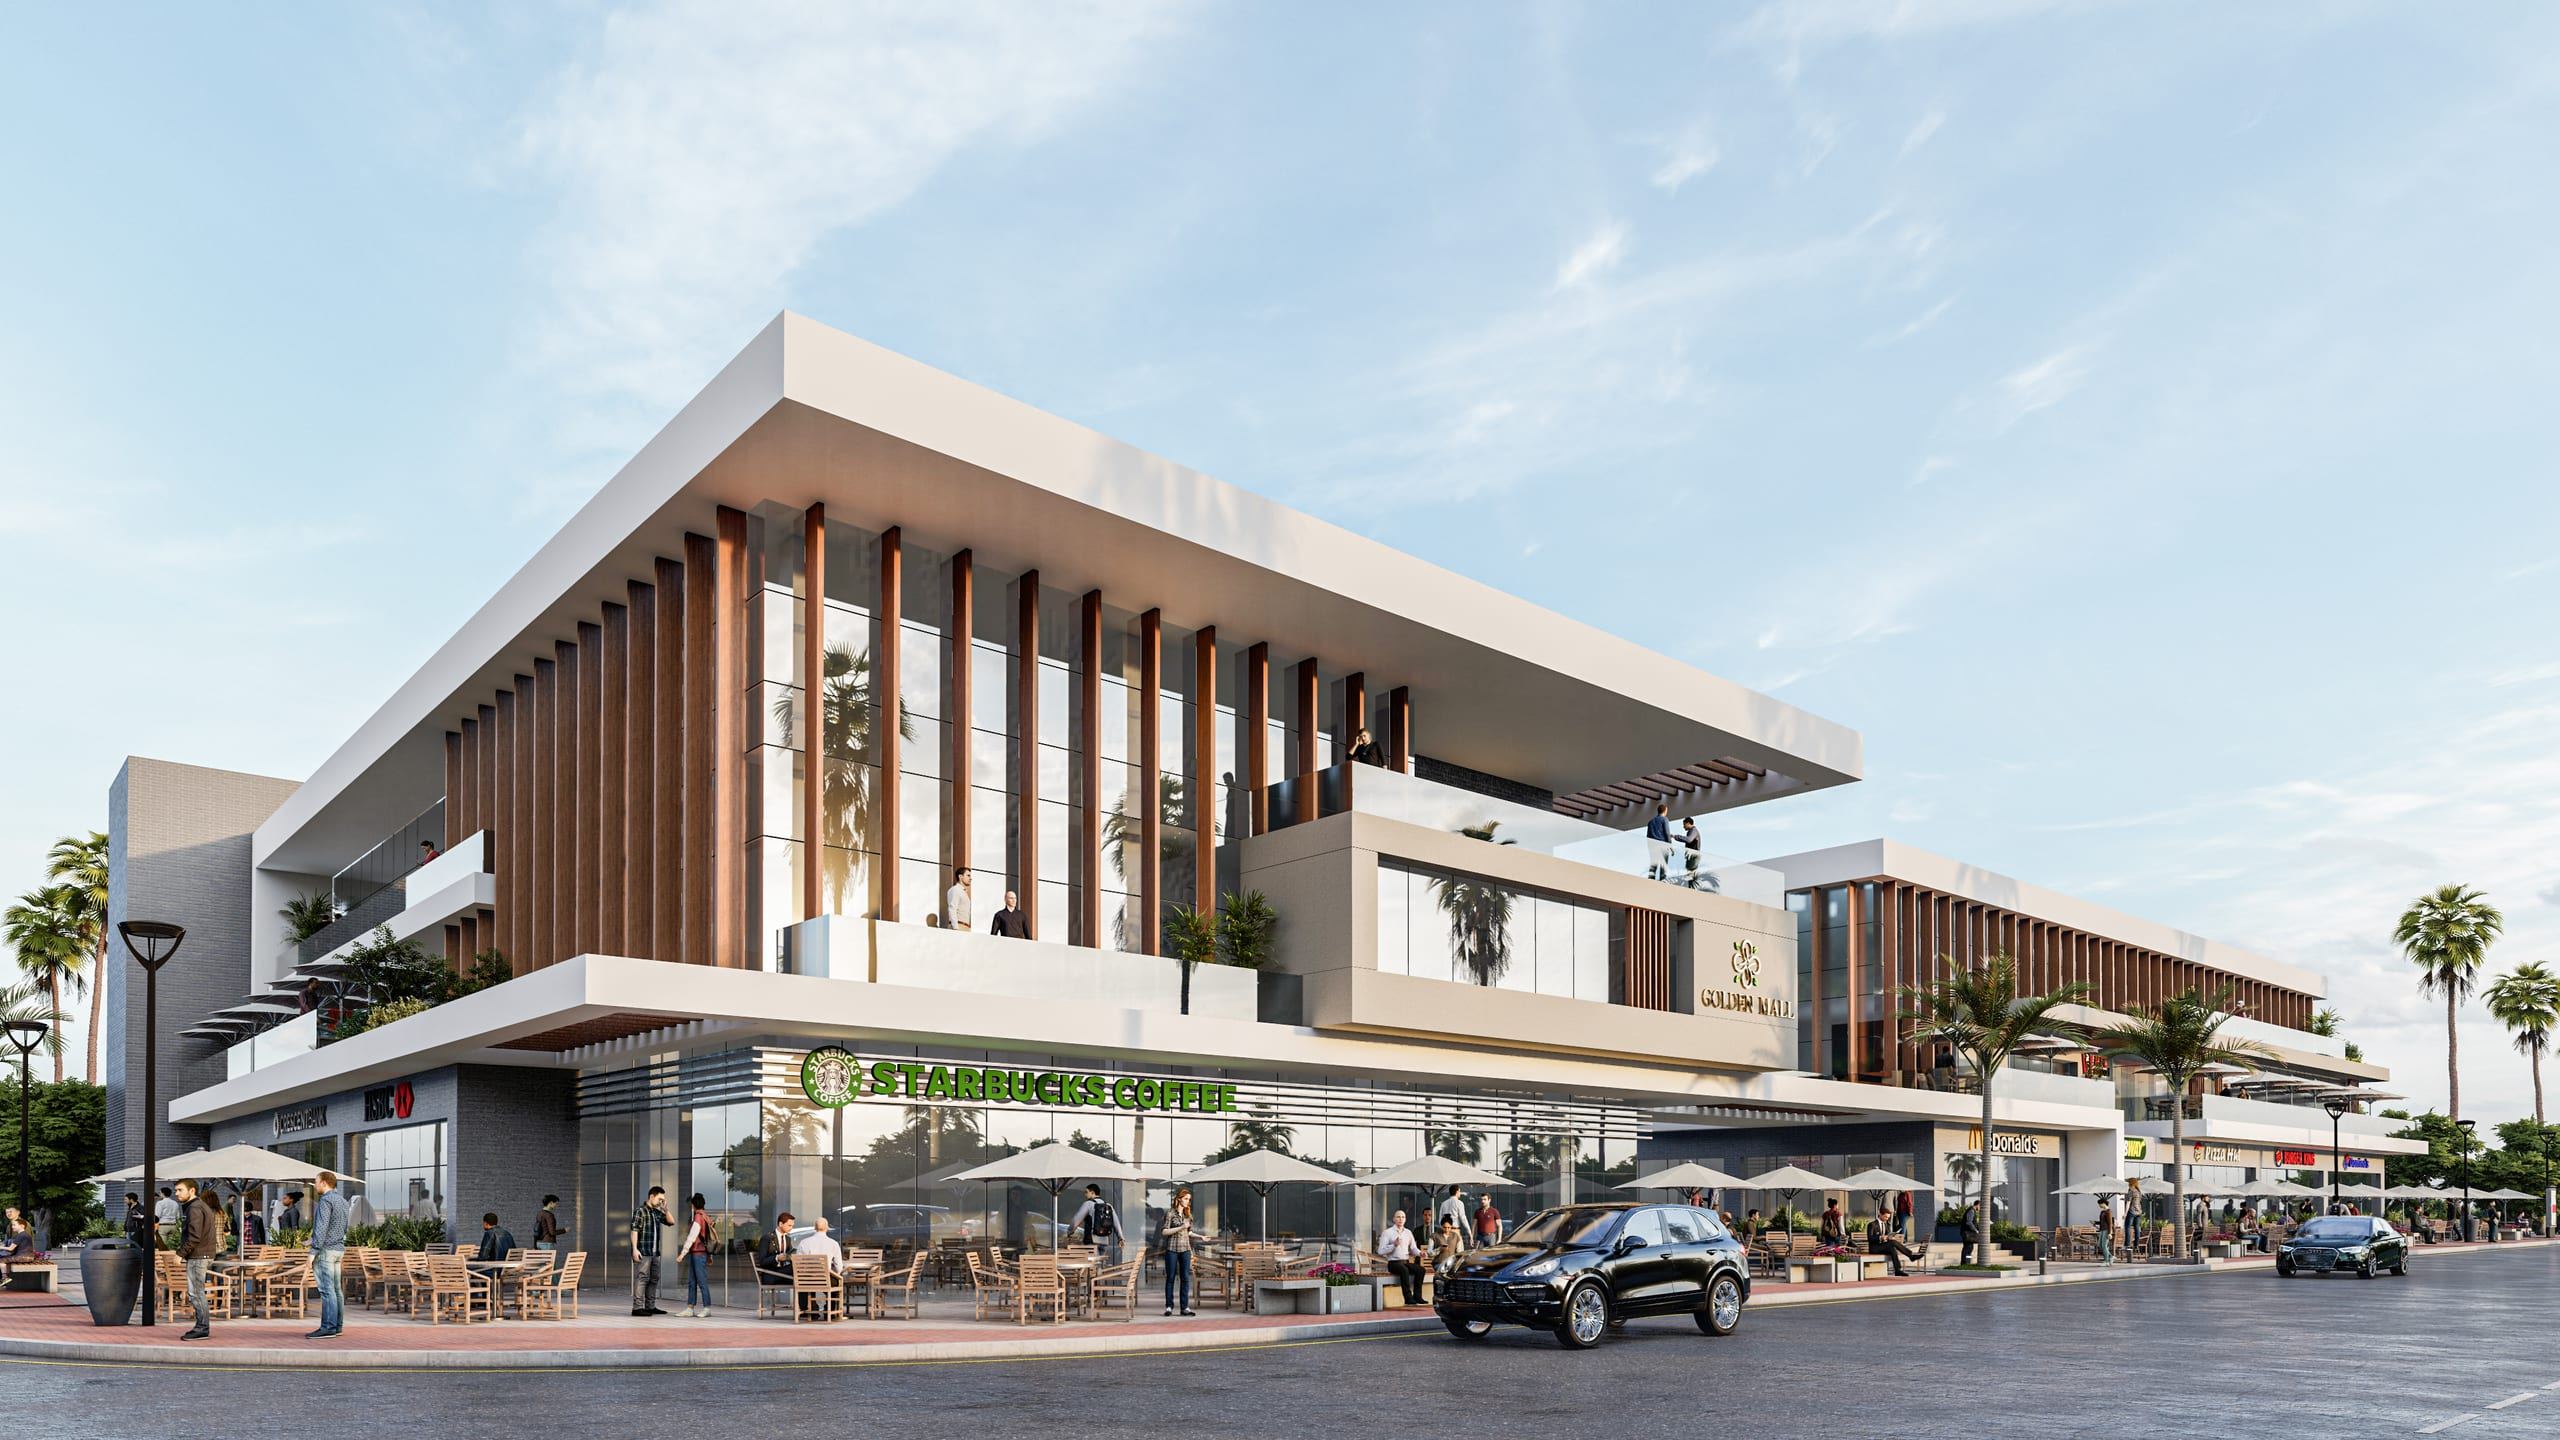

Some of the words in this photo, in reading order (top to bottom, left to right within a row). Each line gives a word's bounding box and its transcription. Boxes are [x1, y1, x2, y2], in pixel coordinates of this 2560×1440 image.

[1701, 989, 1753, 1014] GOLDEN
[1758, 996, 1795, 1019] MALL
[808, 1048, 860, 1076] STARBUCKS
[813, 1089, 854, 1105] COFFEE
[871, 1062, 1106, 1107] STARBUCKS
[1113, 1078, 1238, 1112] COFFEE
[364, 1085, 395, 1122] HSBC
[1968, 1126, 2039, 1153] MDonald's
[2204, 1145, 2225, 1162] Pizza
